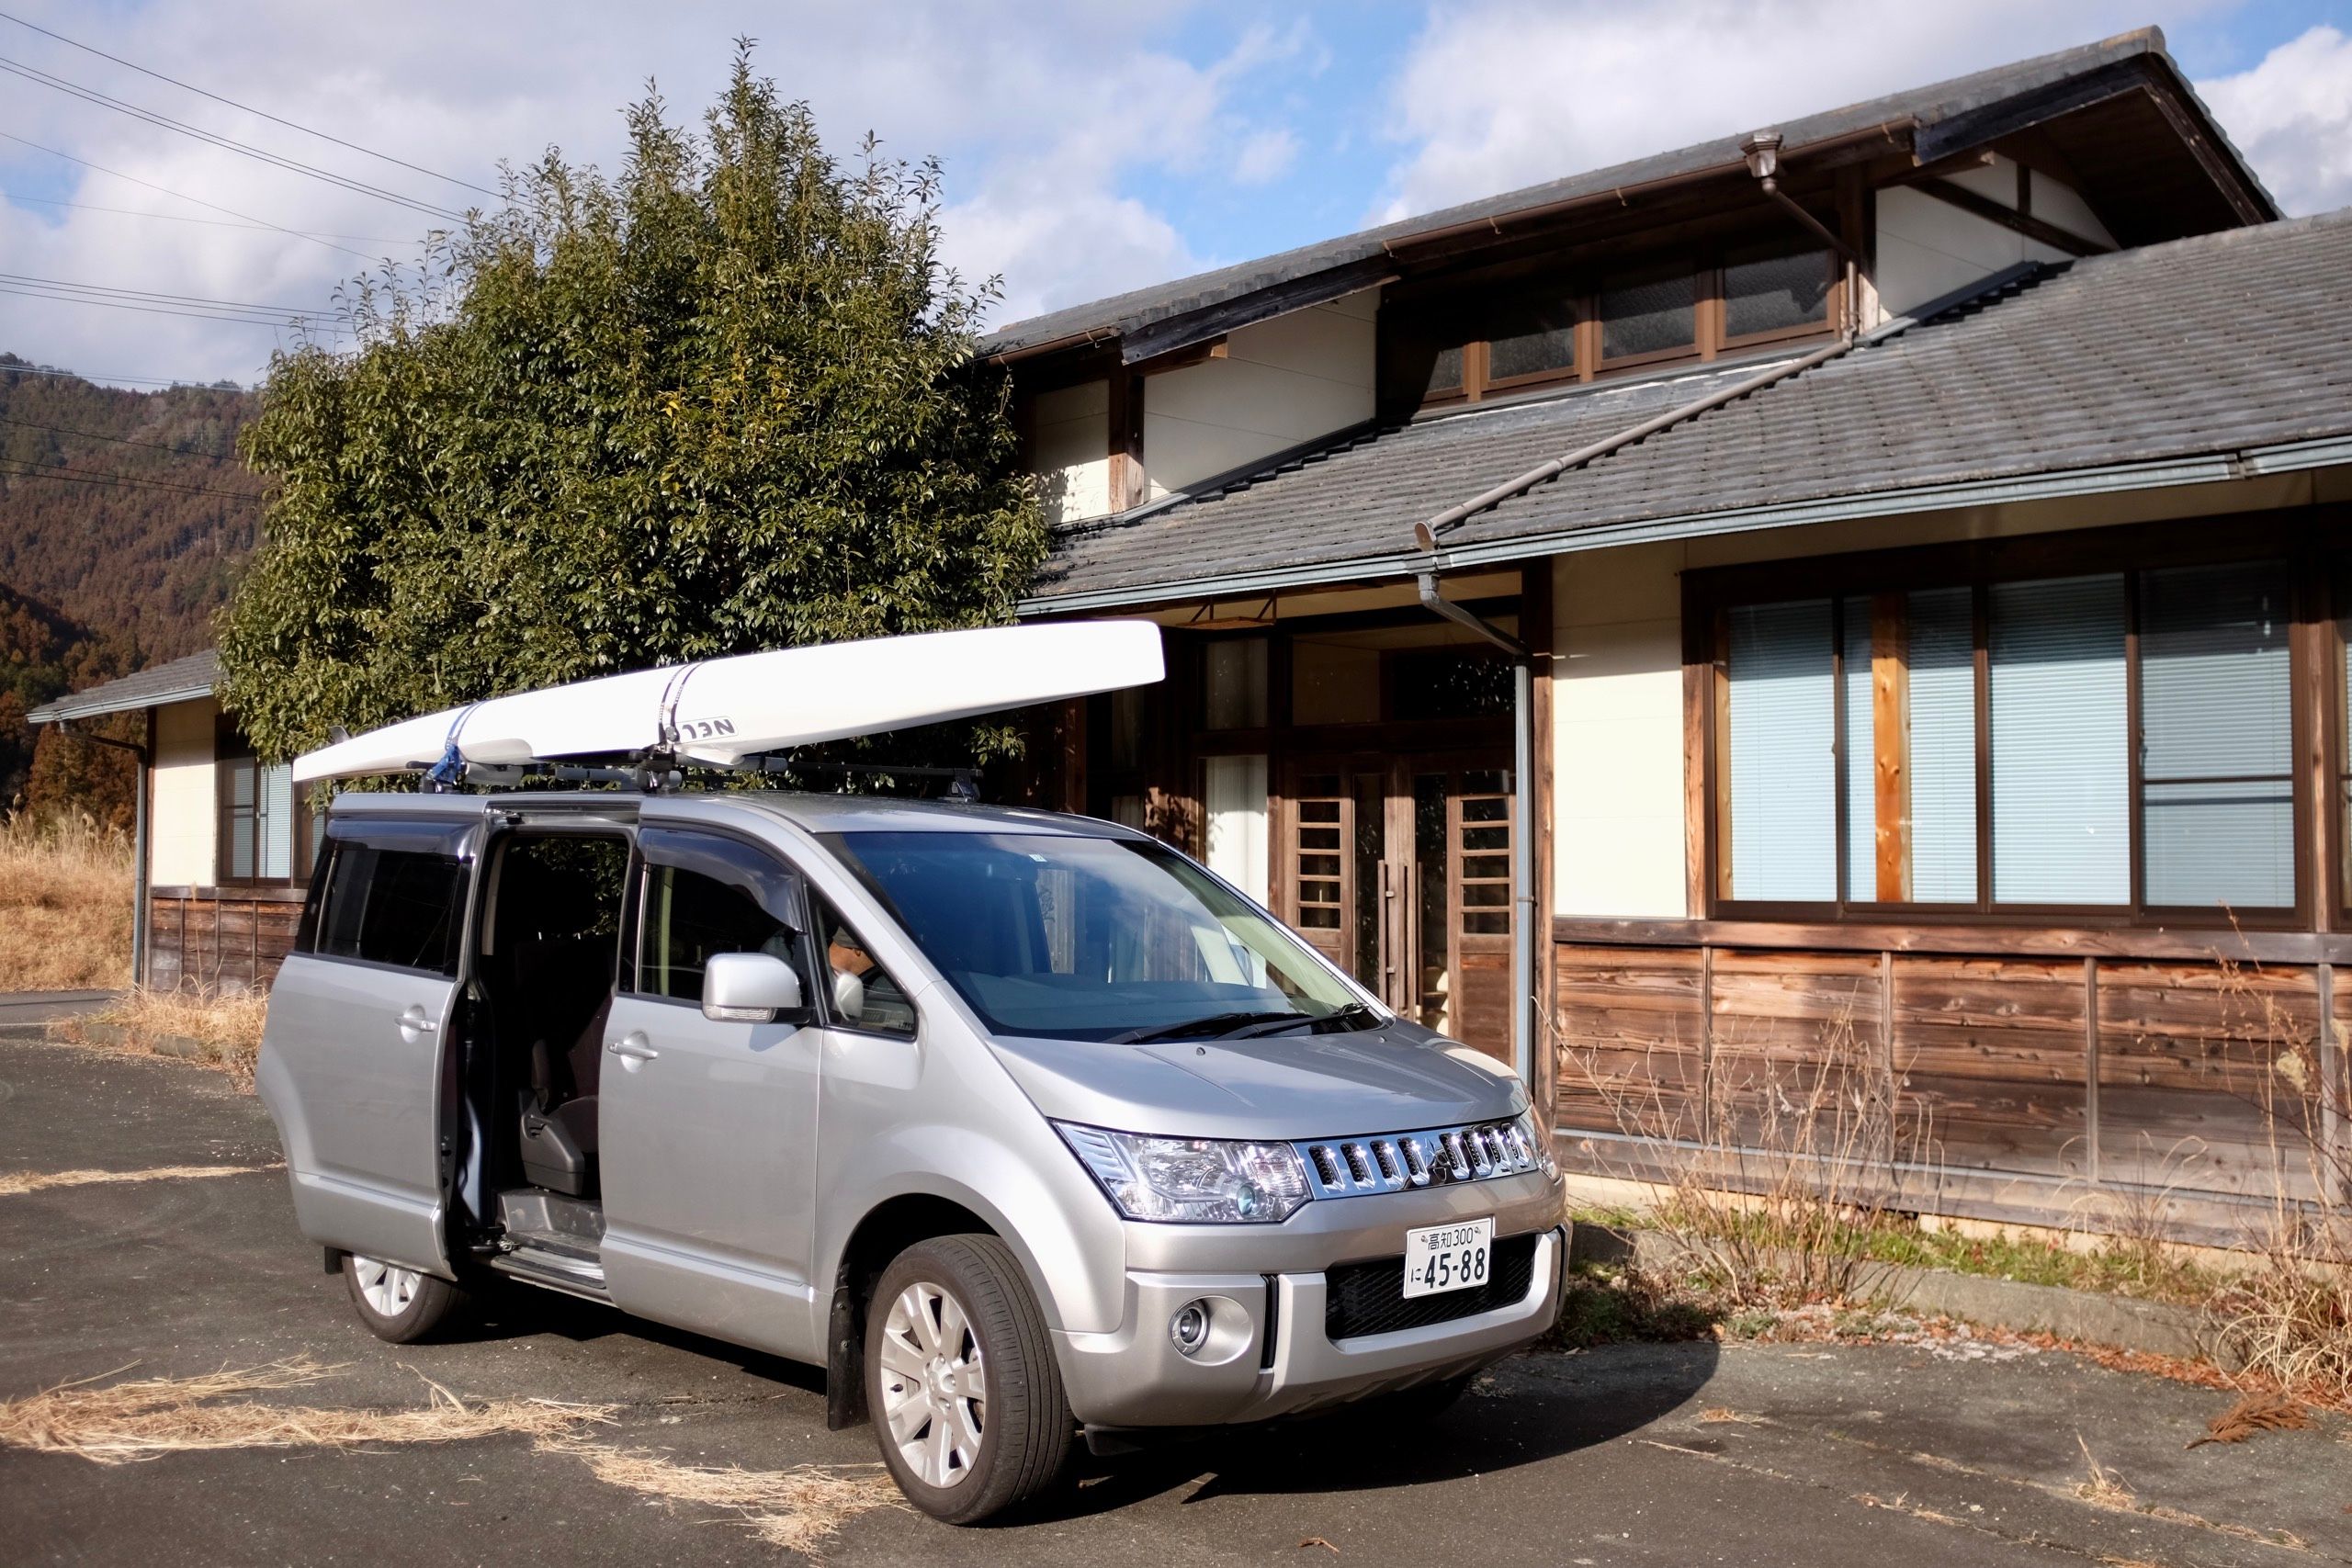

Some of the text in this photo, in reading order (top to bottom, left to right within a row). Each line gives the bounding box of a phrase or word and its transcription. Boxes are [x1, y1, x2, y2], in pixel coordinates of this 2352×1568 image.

[682, 718, 735, 739] NEL
[1410, 1247, 1486, 1289] に 45-88
